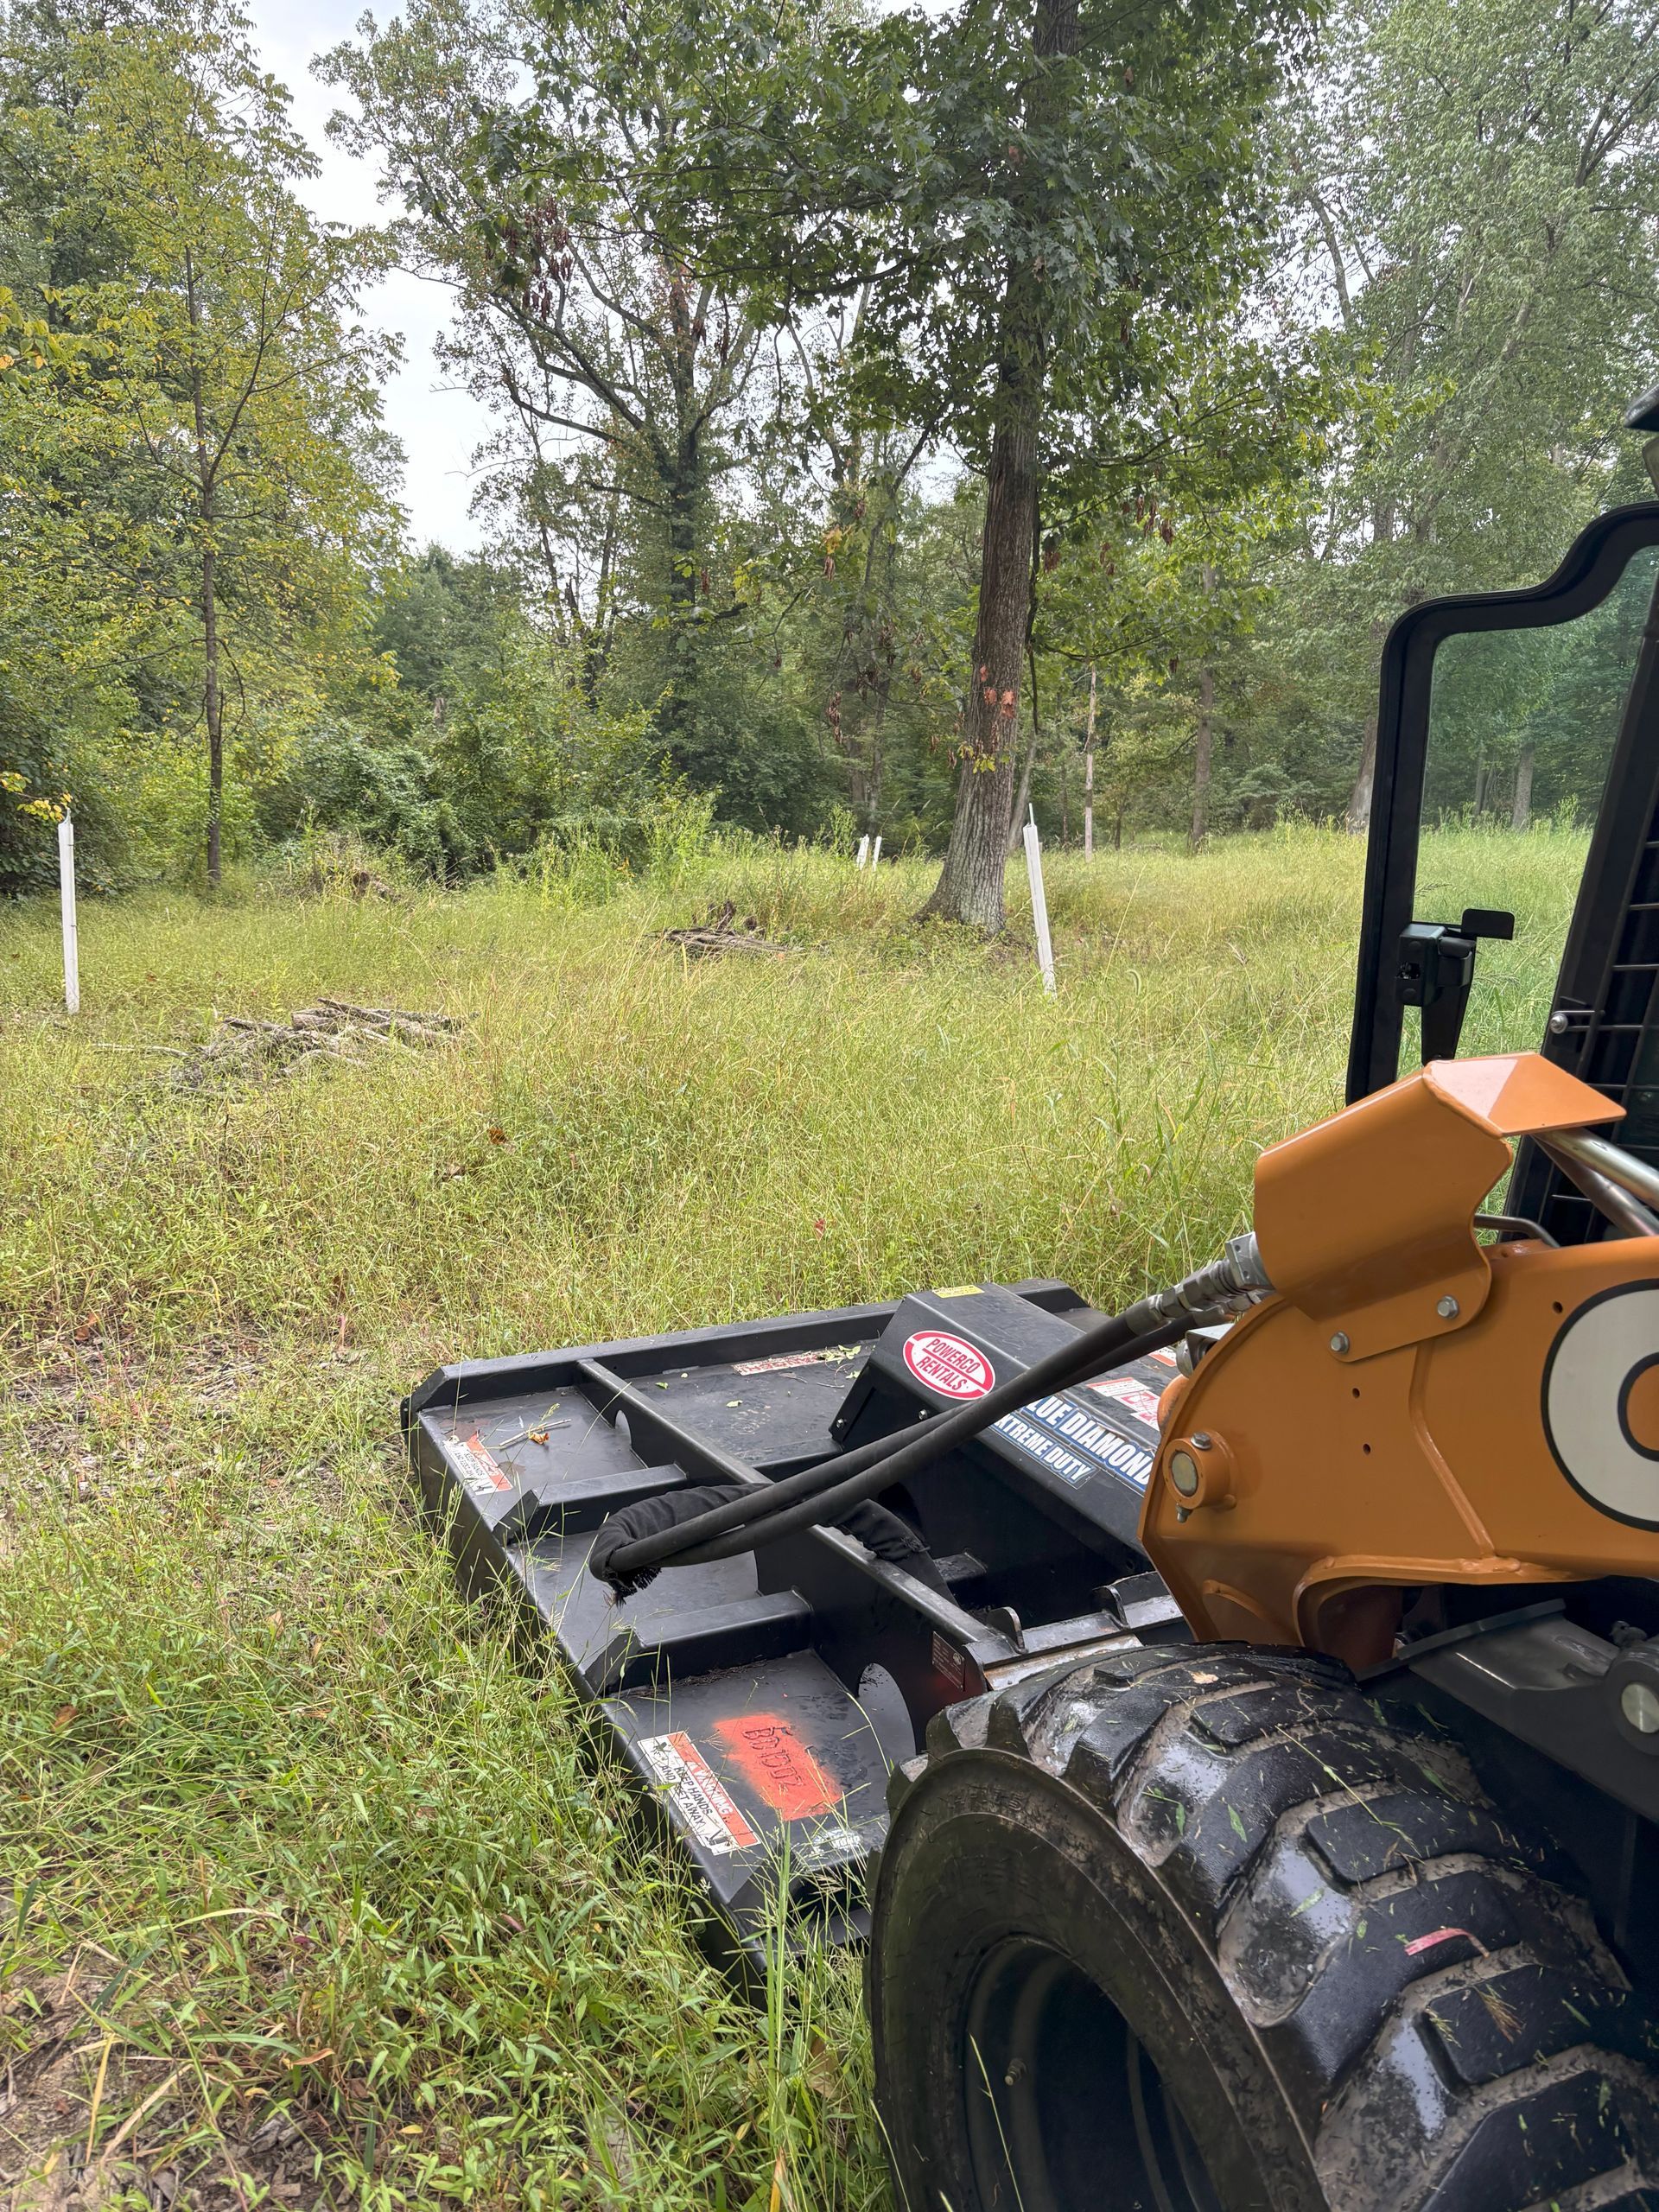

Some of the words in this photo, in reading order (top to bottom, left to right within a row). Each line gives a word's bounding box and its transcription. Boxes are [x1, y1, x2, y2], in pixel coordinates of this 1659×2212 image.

[916, 1356, 968, 1391] RENTALS
[926, 1338, 981, 1374] POWERCO
[1026, 1395, 1073, 1426] LUE
[994, 1413, 1053, 1456] XTREME
[1044, 1446, 1092, 1480] DUTY
[661, 1765, 676, 1781] AND
[683, 1802, 706, 1827] AWAY
[674, 1766, 695, 1786] KEEP
[688, 1787, 713, 1815] HANDS
